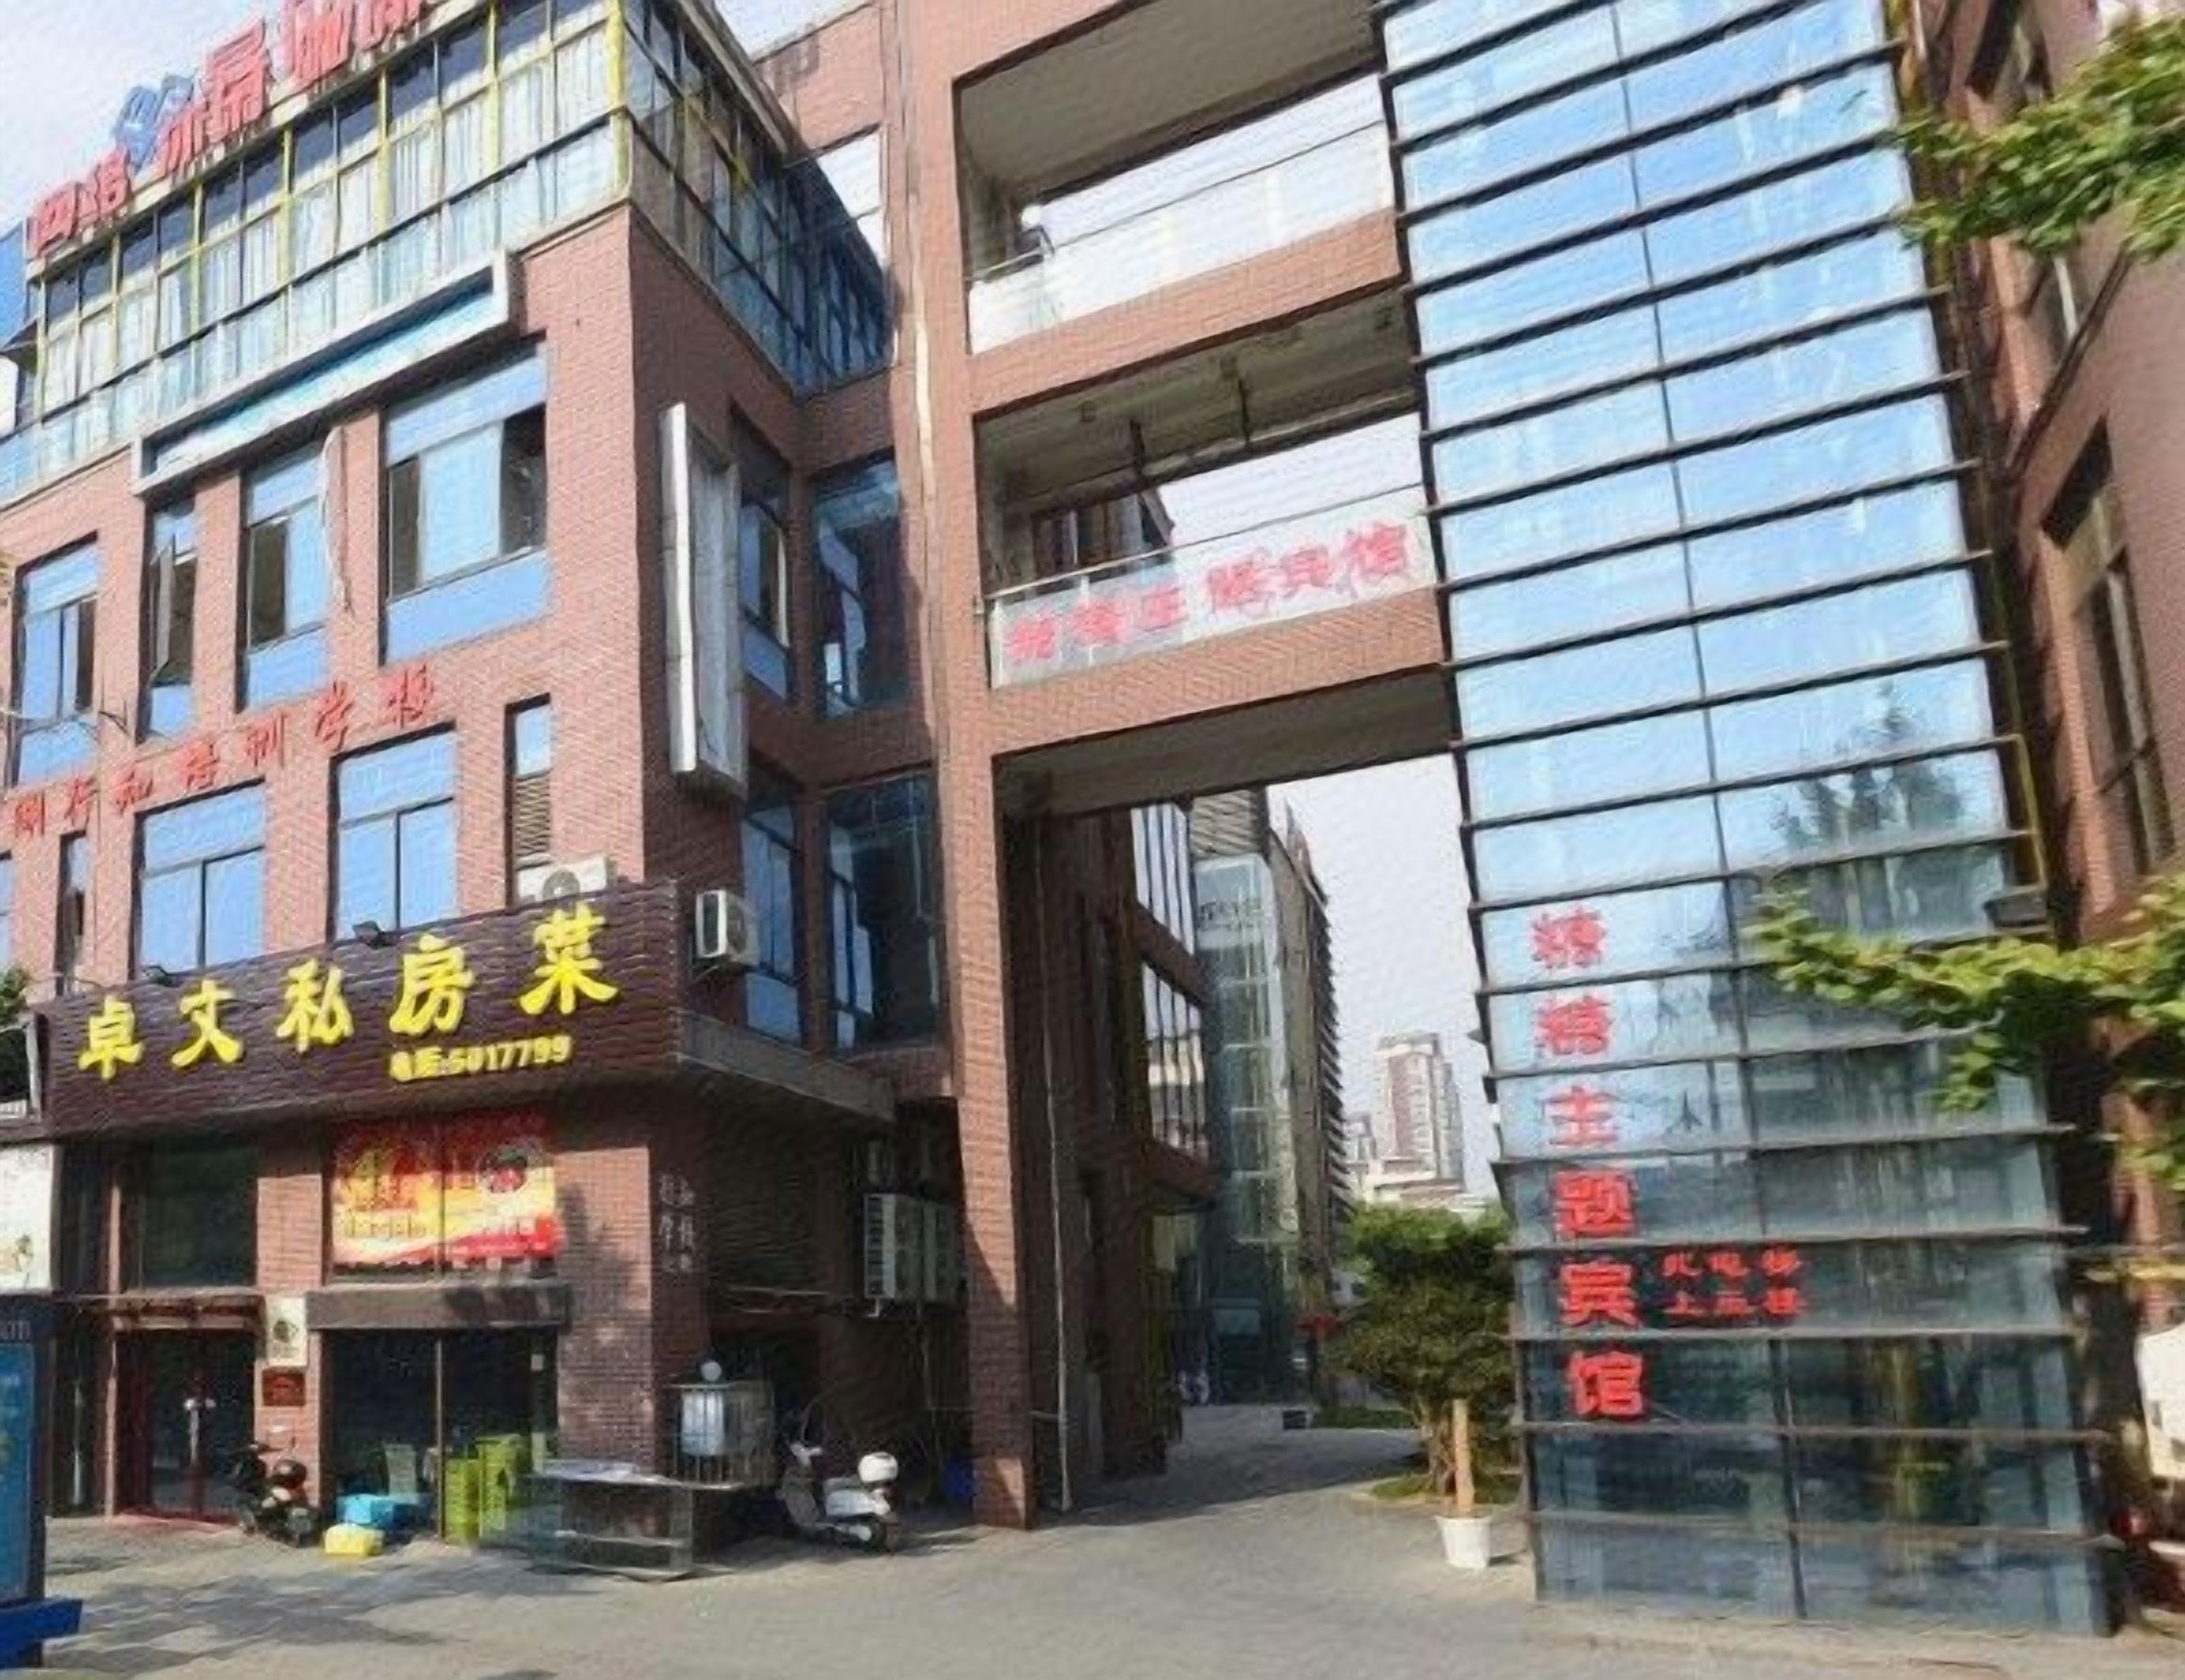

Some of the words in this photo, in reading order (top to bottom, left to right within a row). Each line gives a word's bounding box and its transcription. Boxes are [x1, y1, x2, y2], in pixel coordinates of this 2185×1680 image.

[78, 902, 618, 1079] 卓文私房菜
